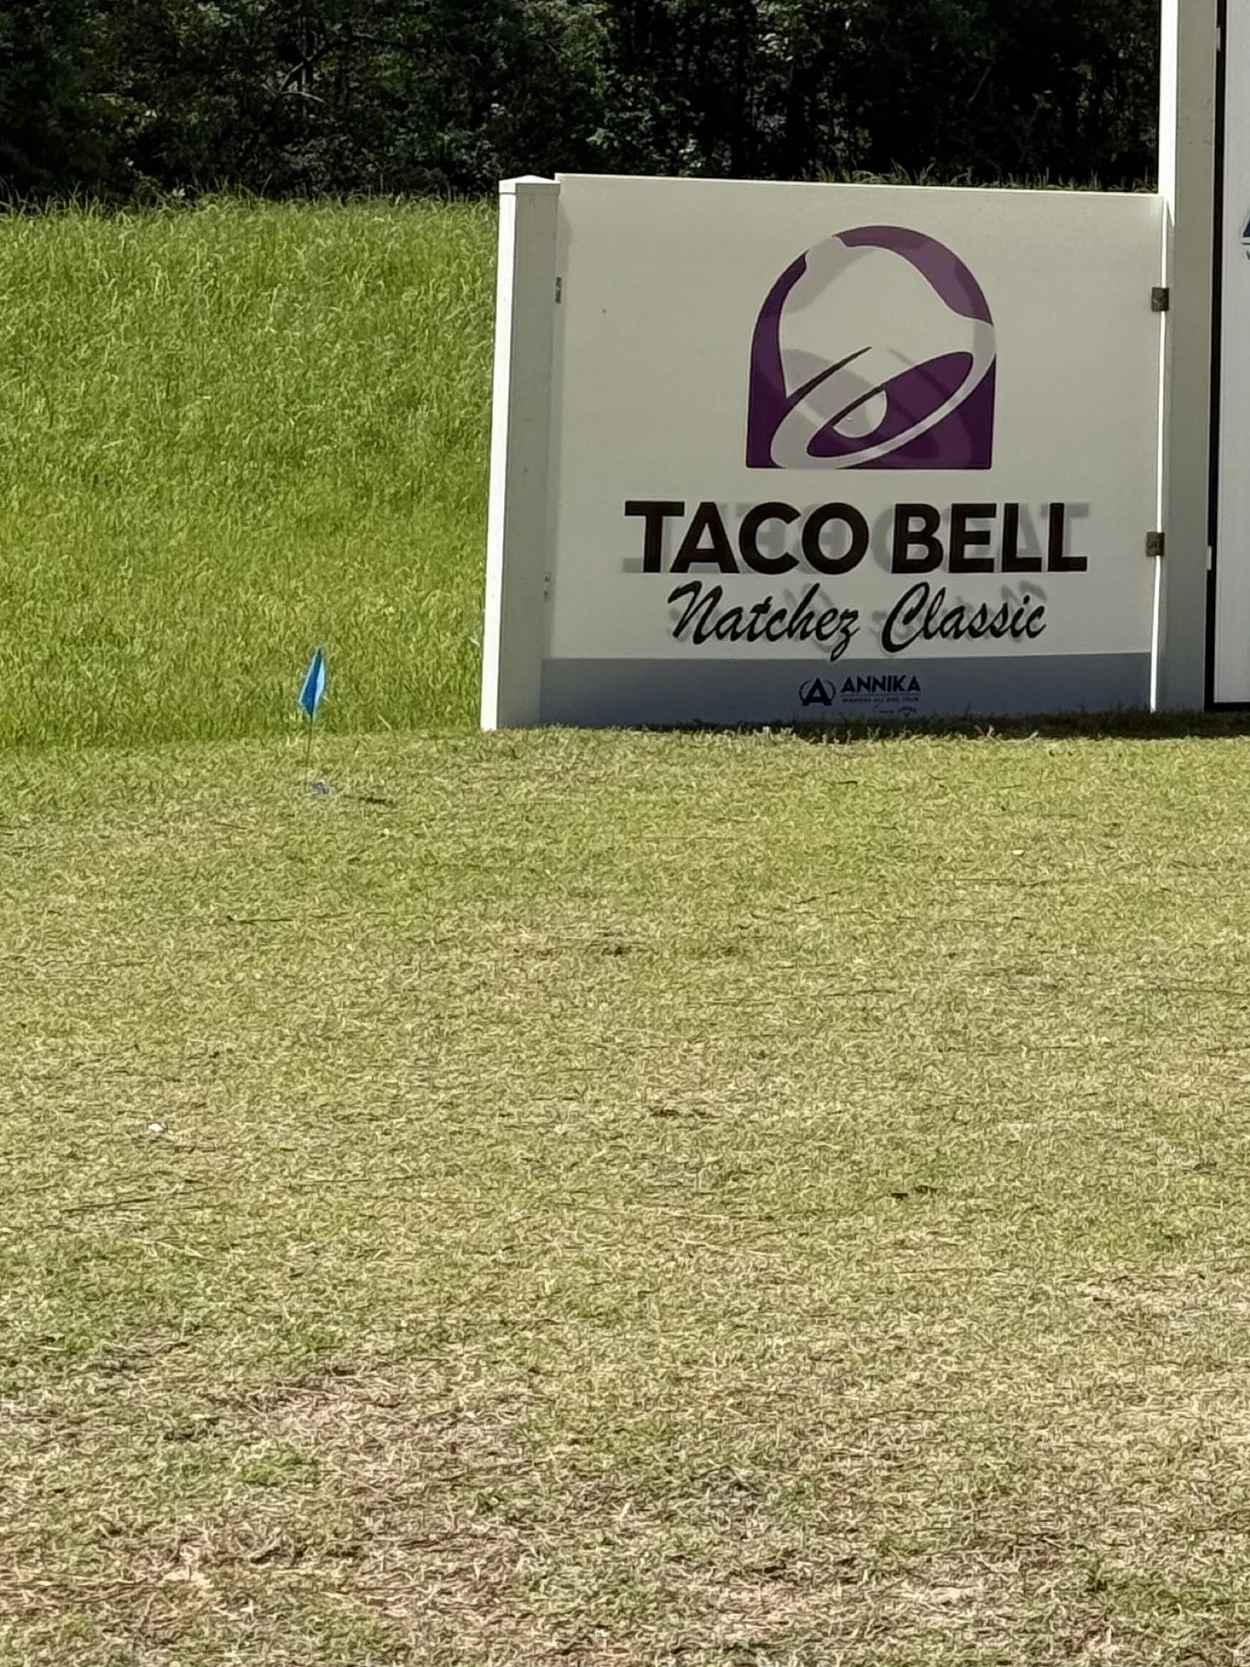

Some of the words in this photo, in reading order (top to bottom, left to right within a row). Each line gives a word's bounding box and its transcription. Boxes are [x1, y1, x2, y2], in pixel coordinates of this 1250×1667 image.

[624, 500, 869, 575] TACO
[891, 502, 1088, 573] BELL
[667, 580, 860, 662] Natchez
[881, 581, 1047, 653] Classic
[841, 675, 921, 692] ANNIKA
